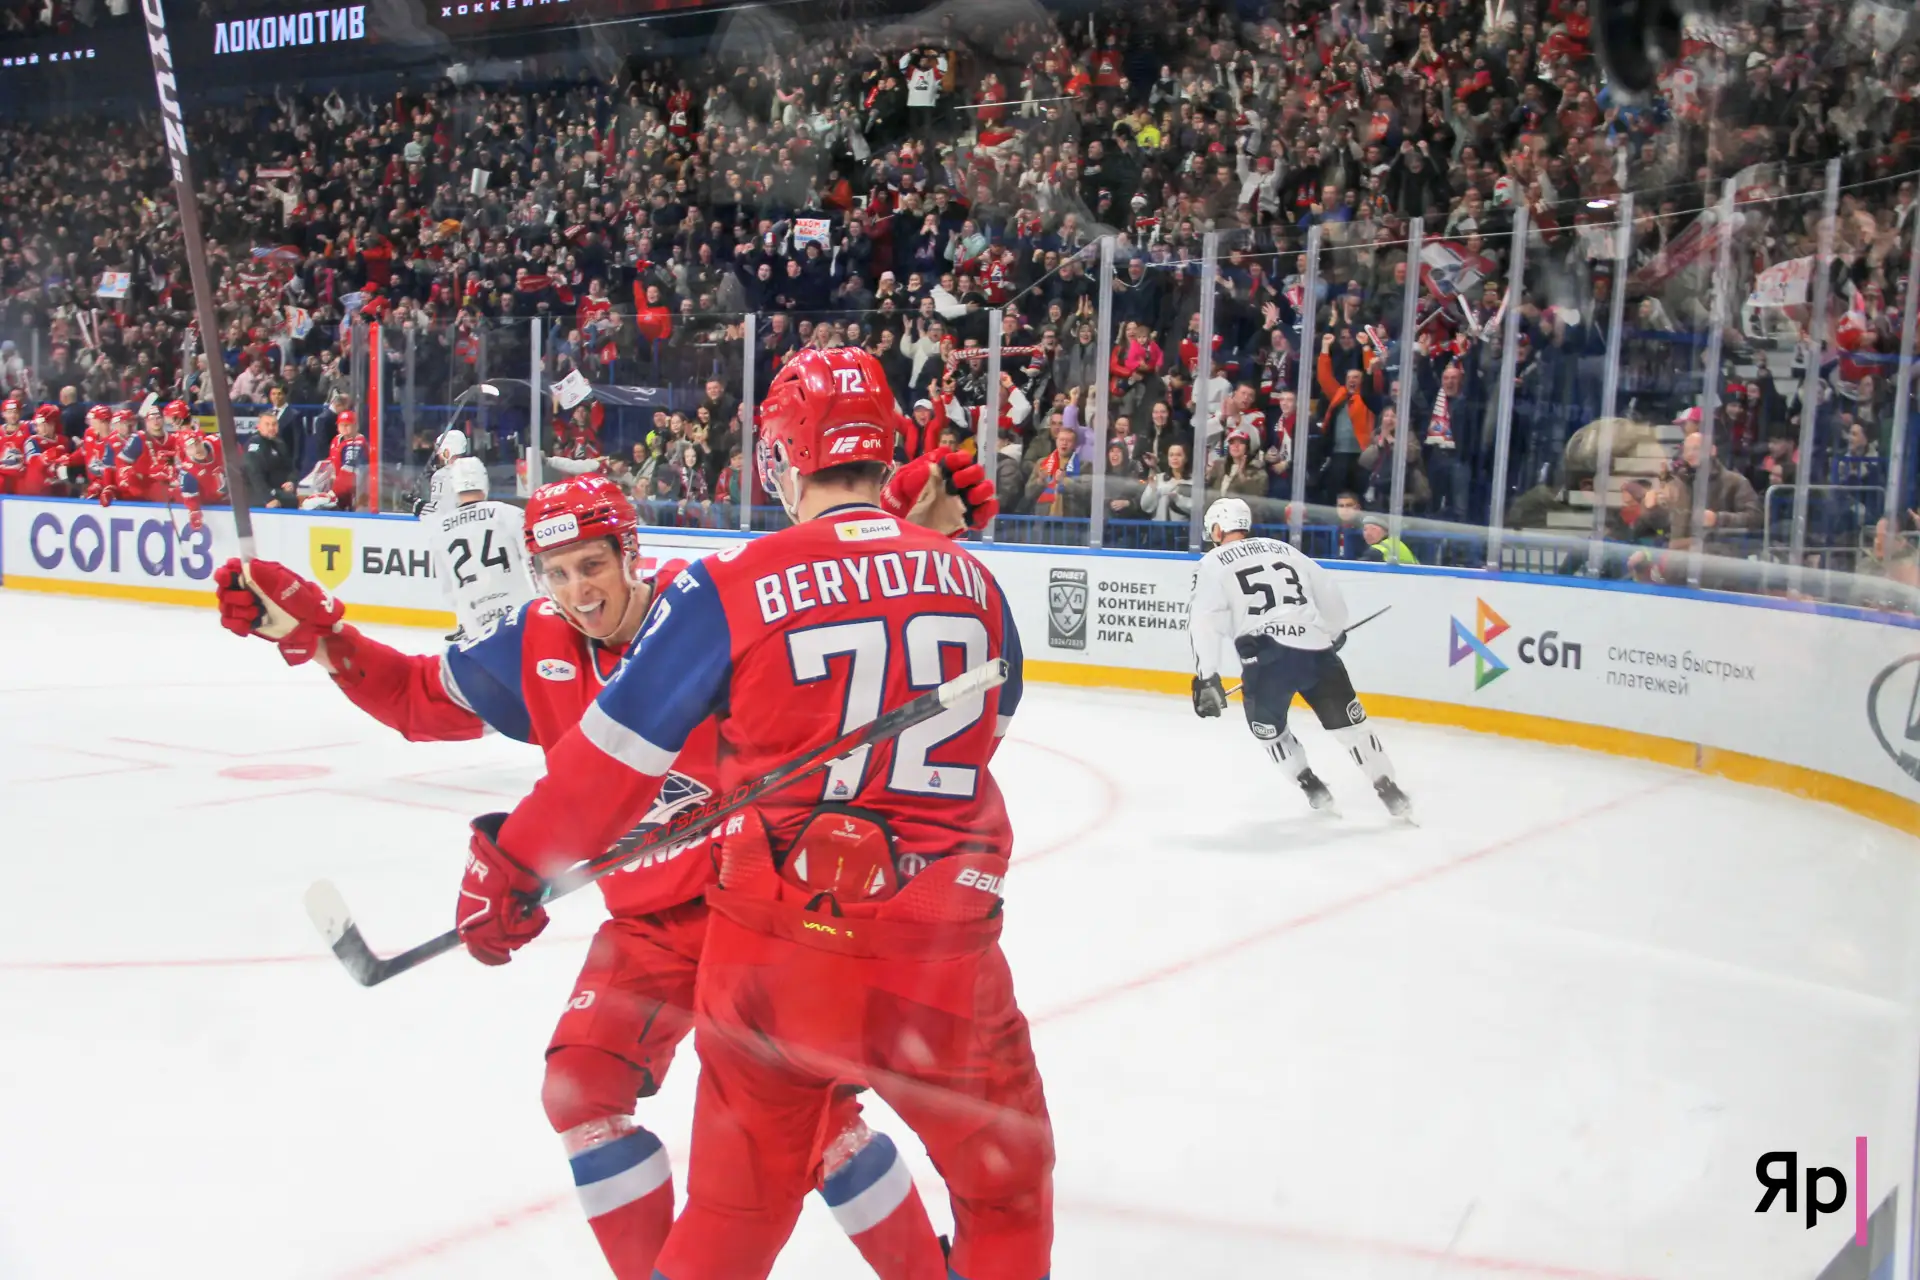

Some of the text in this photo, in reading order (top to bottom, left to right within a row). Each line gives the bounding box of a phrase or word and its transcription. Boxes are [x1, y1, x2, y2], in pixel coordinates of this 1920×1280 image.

[214, 5, 366, 54] ЛОКОМОТИВ
[832, 368, 866, 394] 72
[442, 507, 497, 532] SHAROV
[536, 521, 576, 540] согаз
[861, 525, 892, 534] БАНК
[1238, 518, 1249, 529] 53
[30, 511, 214, 581] согаз
[447, 529, 511, 589] 24
[362, 546, 437, 579] БАН
[1051, 570, 1086, 581] FONBET
[755, 550, 989, 623] BERYOZKIN
[1098, 581, 1157, 595] ФОНБЕТ
[1235, 561, 1308, 616] 53
[1097, 613, 1187, 631] ХОККЕЙНАЯ
[1255, 623, 1306, 636] ОНАР
[1050, 637, 1084, 647] 2024/2025
[1096, 630, 1134, 644] ЛИГА
[1517, 630, 1582, 670] сбп
[1607, 644, 1756, 682] система быстрых
[1606, 669, 1689, 696] платежей
[784, 612, 989, 802] 72
[632, 785, 750, 854] JETSPEED
